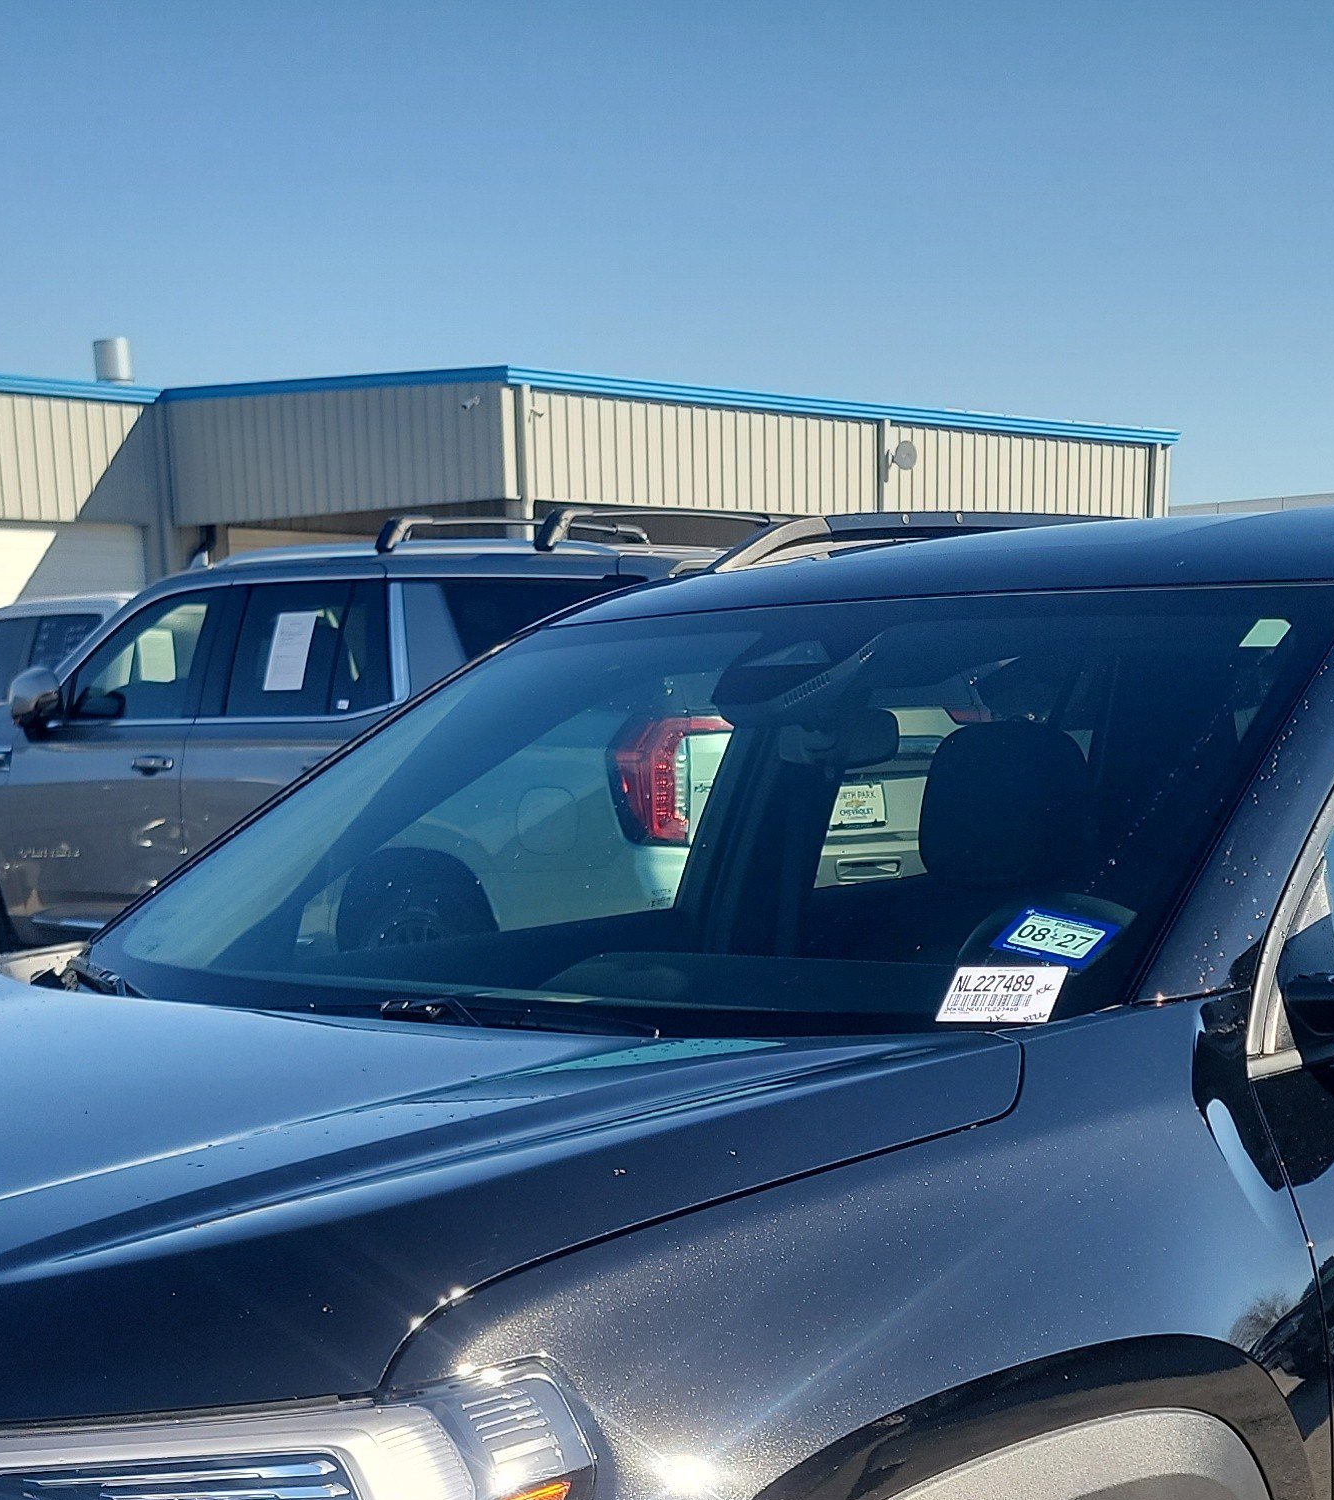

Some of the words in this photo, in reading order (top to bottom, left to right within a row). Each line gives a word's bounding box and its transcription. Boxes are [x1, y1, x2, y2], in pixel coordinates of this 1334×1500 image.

[1017, 924, 1052, 943] 08
[1055, 933, 1094, 951] 27
[952, 974, 1036, 993] NL227489
